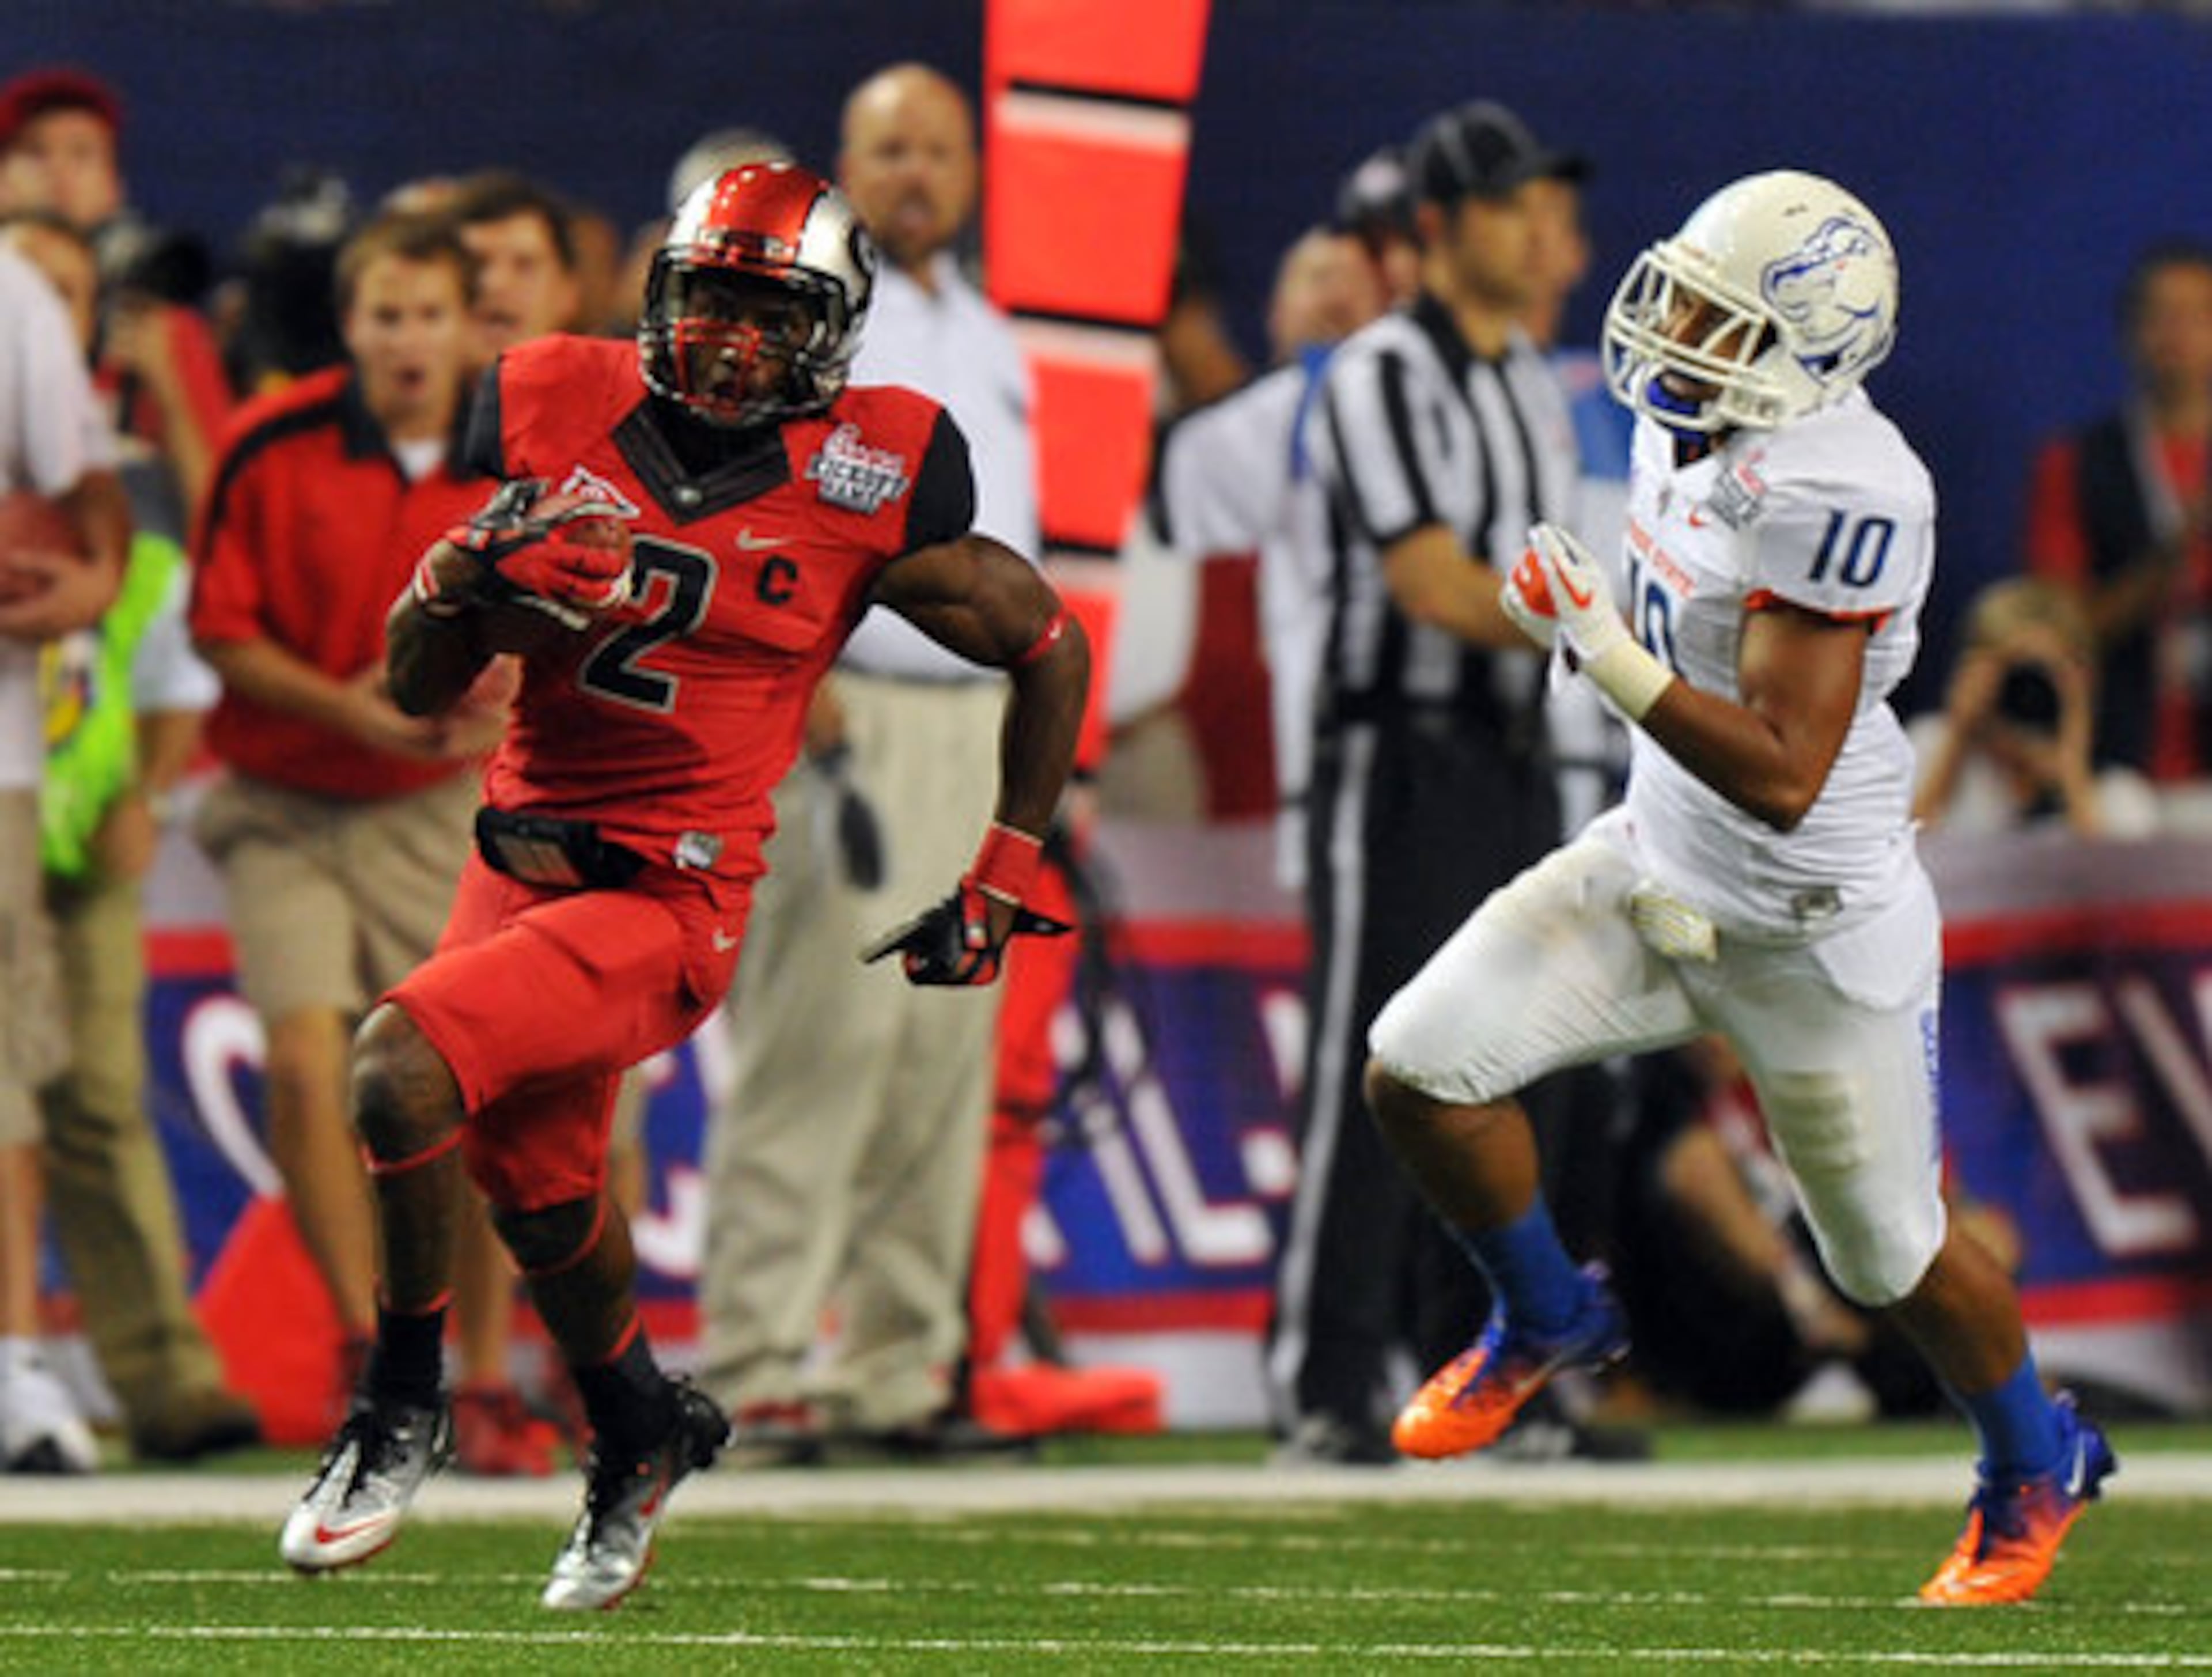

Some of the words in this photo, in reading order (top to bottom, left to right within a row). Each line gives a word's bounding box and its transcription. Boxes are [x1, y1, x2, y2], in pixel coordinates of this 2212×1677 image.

[755, 554, 797, 606] C
[1808, 508, 1896, 588] 10
[578, 533, 719, 714] 2
